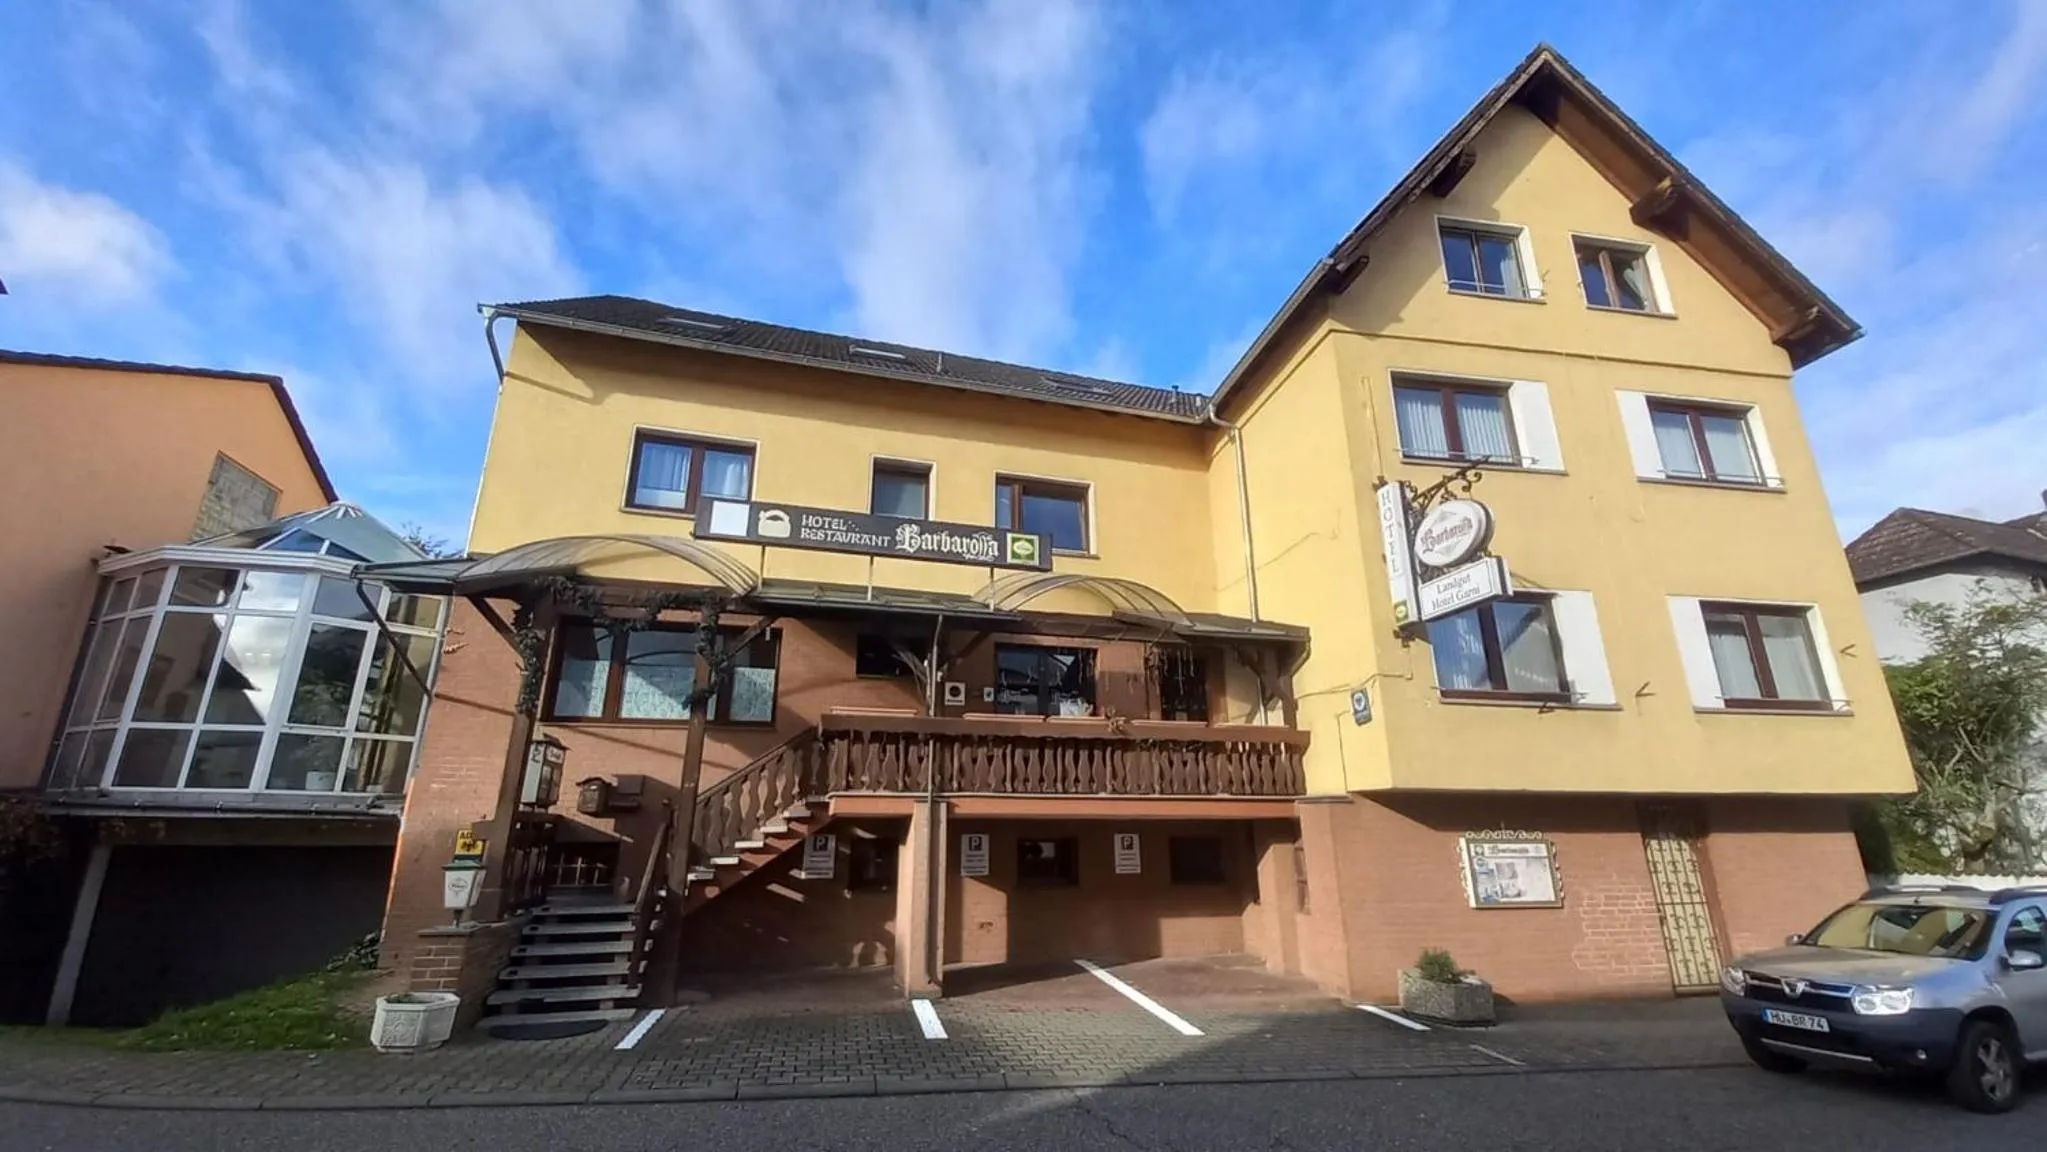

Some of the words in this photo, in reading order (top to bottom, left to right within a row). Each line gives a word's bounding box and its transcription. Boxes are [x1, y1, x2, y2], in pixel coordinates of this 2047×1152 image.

[801, 513, 847, 531] HOTEL
[1381, 490, 1399, 574] HOTEL
[800, 527, 891, 547] RESTAURANT
[1436, 573, 1471, 595] Landgut
[1431, 593, 1454, 611] Hotel
[1456, 586, 1480, 602] Garni
